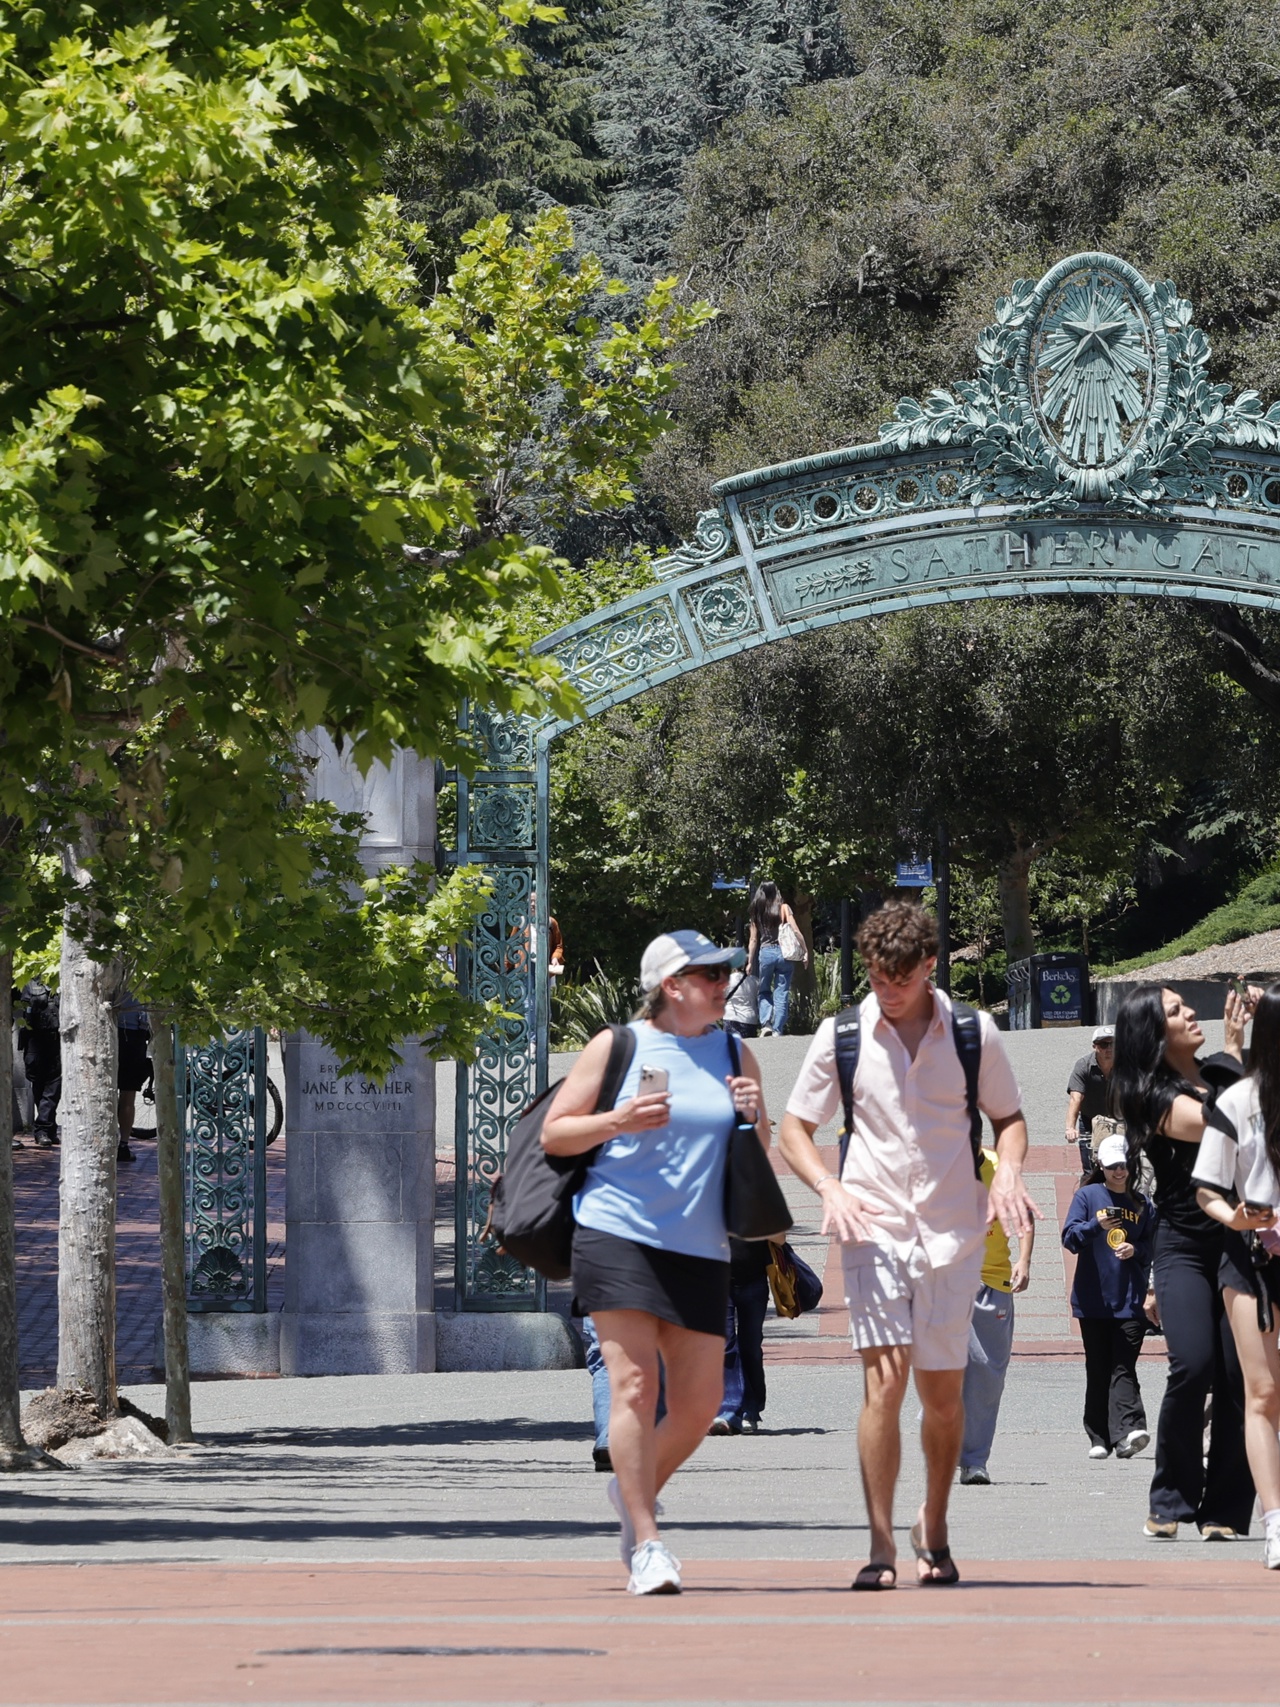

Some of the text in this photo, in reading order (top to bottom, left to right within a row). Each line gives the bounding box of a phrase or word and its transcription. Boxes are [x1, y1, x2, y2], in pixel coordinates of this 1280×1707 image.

[891, 530, 1115, 582] SATHER
[302, 1081, 338, 1095] JANE
[344, 1081, 354, 1095] K
